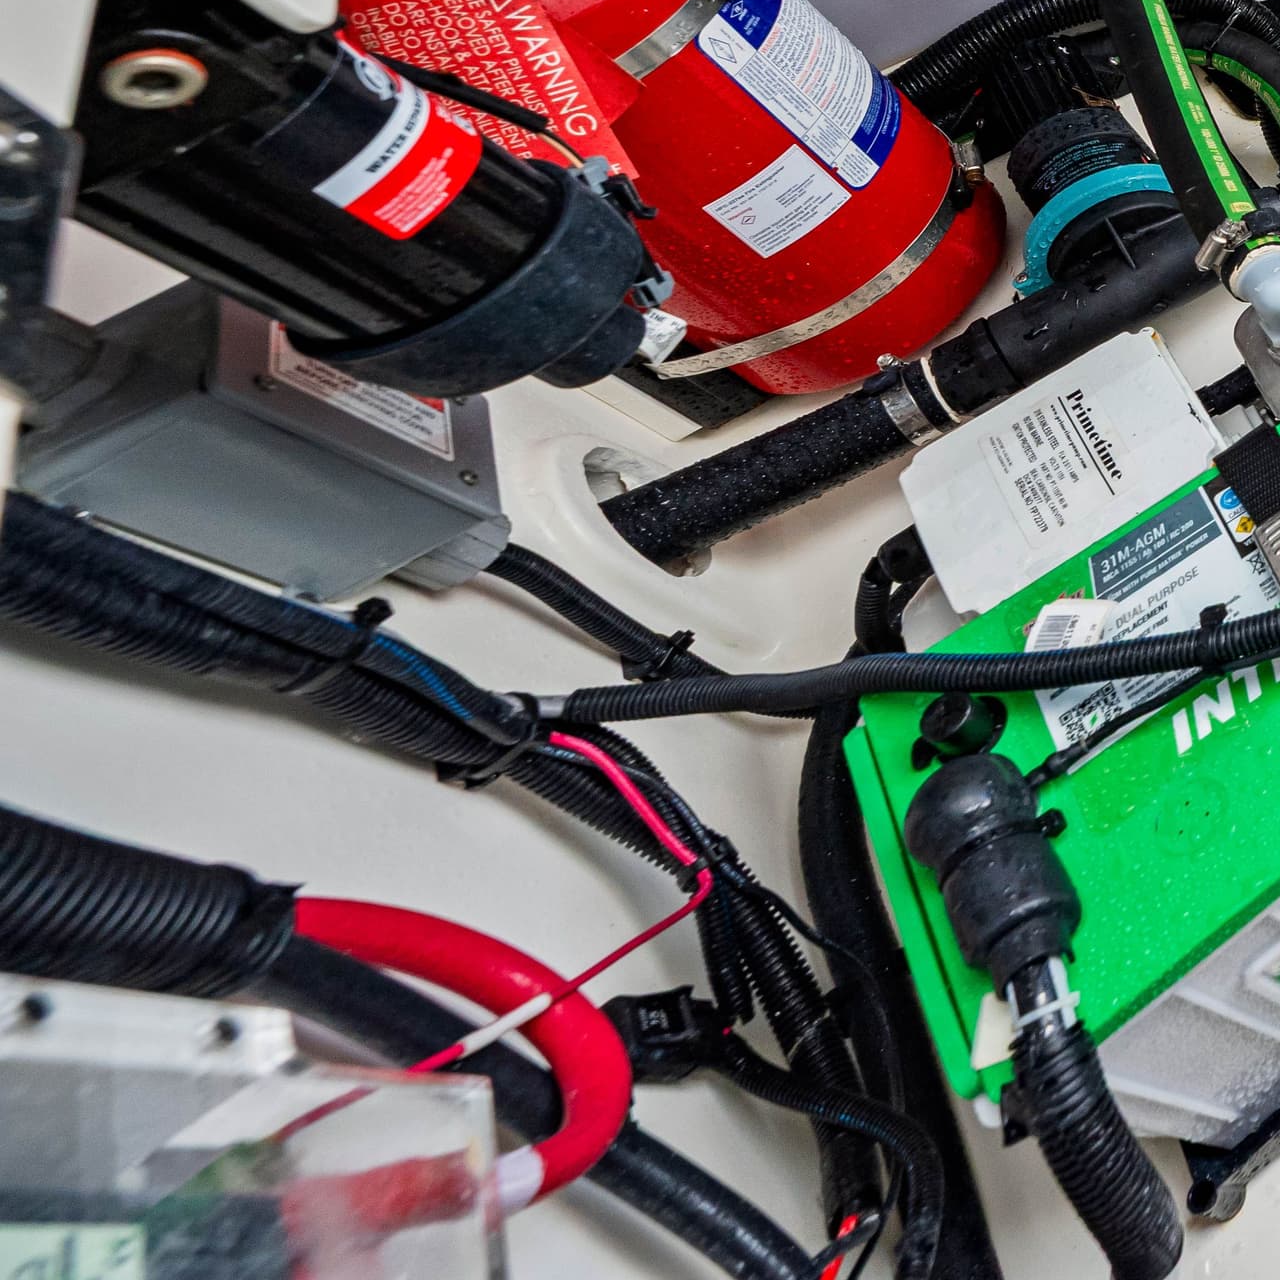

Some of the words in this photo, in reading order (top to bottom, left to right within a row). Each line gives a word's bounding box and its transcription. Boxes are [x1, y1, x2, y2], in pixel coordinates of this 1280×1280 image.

[382, 3, 408, 26] DO
[398, 28, 421, 48] SO
[401, 1, 432, 27] ARE
[454, 51, 472, 63] &
[475, 10, 514, 55] SAFETY
[502, 58, 528, 81] PIN
[517, 83, 549, 114] MUST
[480, 61, 516, 97] AFTER
[505, 4, 598, 137] WARNING
[1064, 387, 1128, 483] Primetime
[1095, 522, 1170, 574] 31M-AGM
[1100, 568, 1120, 583] MCA
[1118, 556, 1139, 571] 1155
[1167, 528, 1181, 540] RC
[1120, 577, 1140, 593] WITH
[1137, 565, 1158, 581] PURE
[1183, 532, 1210, 551] POWER
[1112, 602, 1147, 629] DUAL
[1143, 565, 1203, 607] PURPOSE
[1150, 614, 1170, 630] FREE
